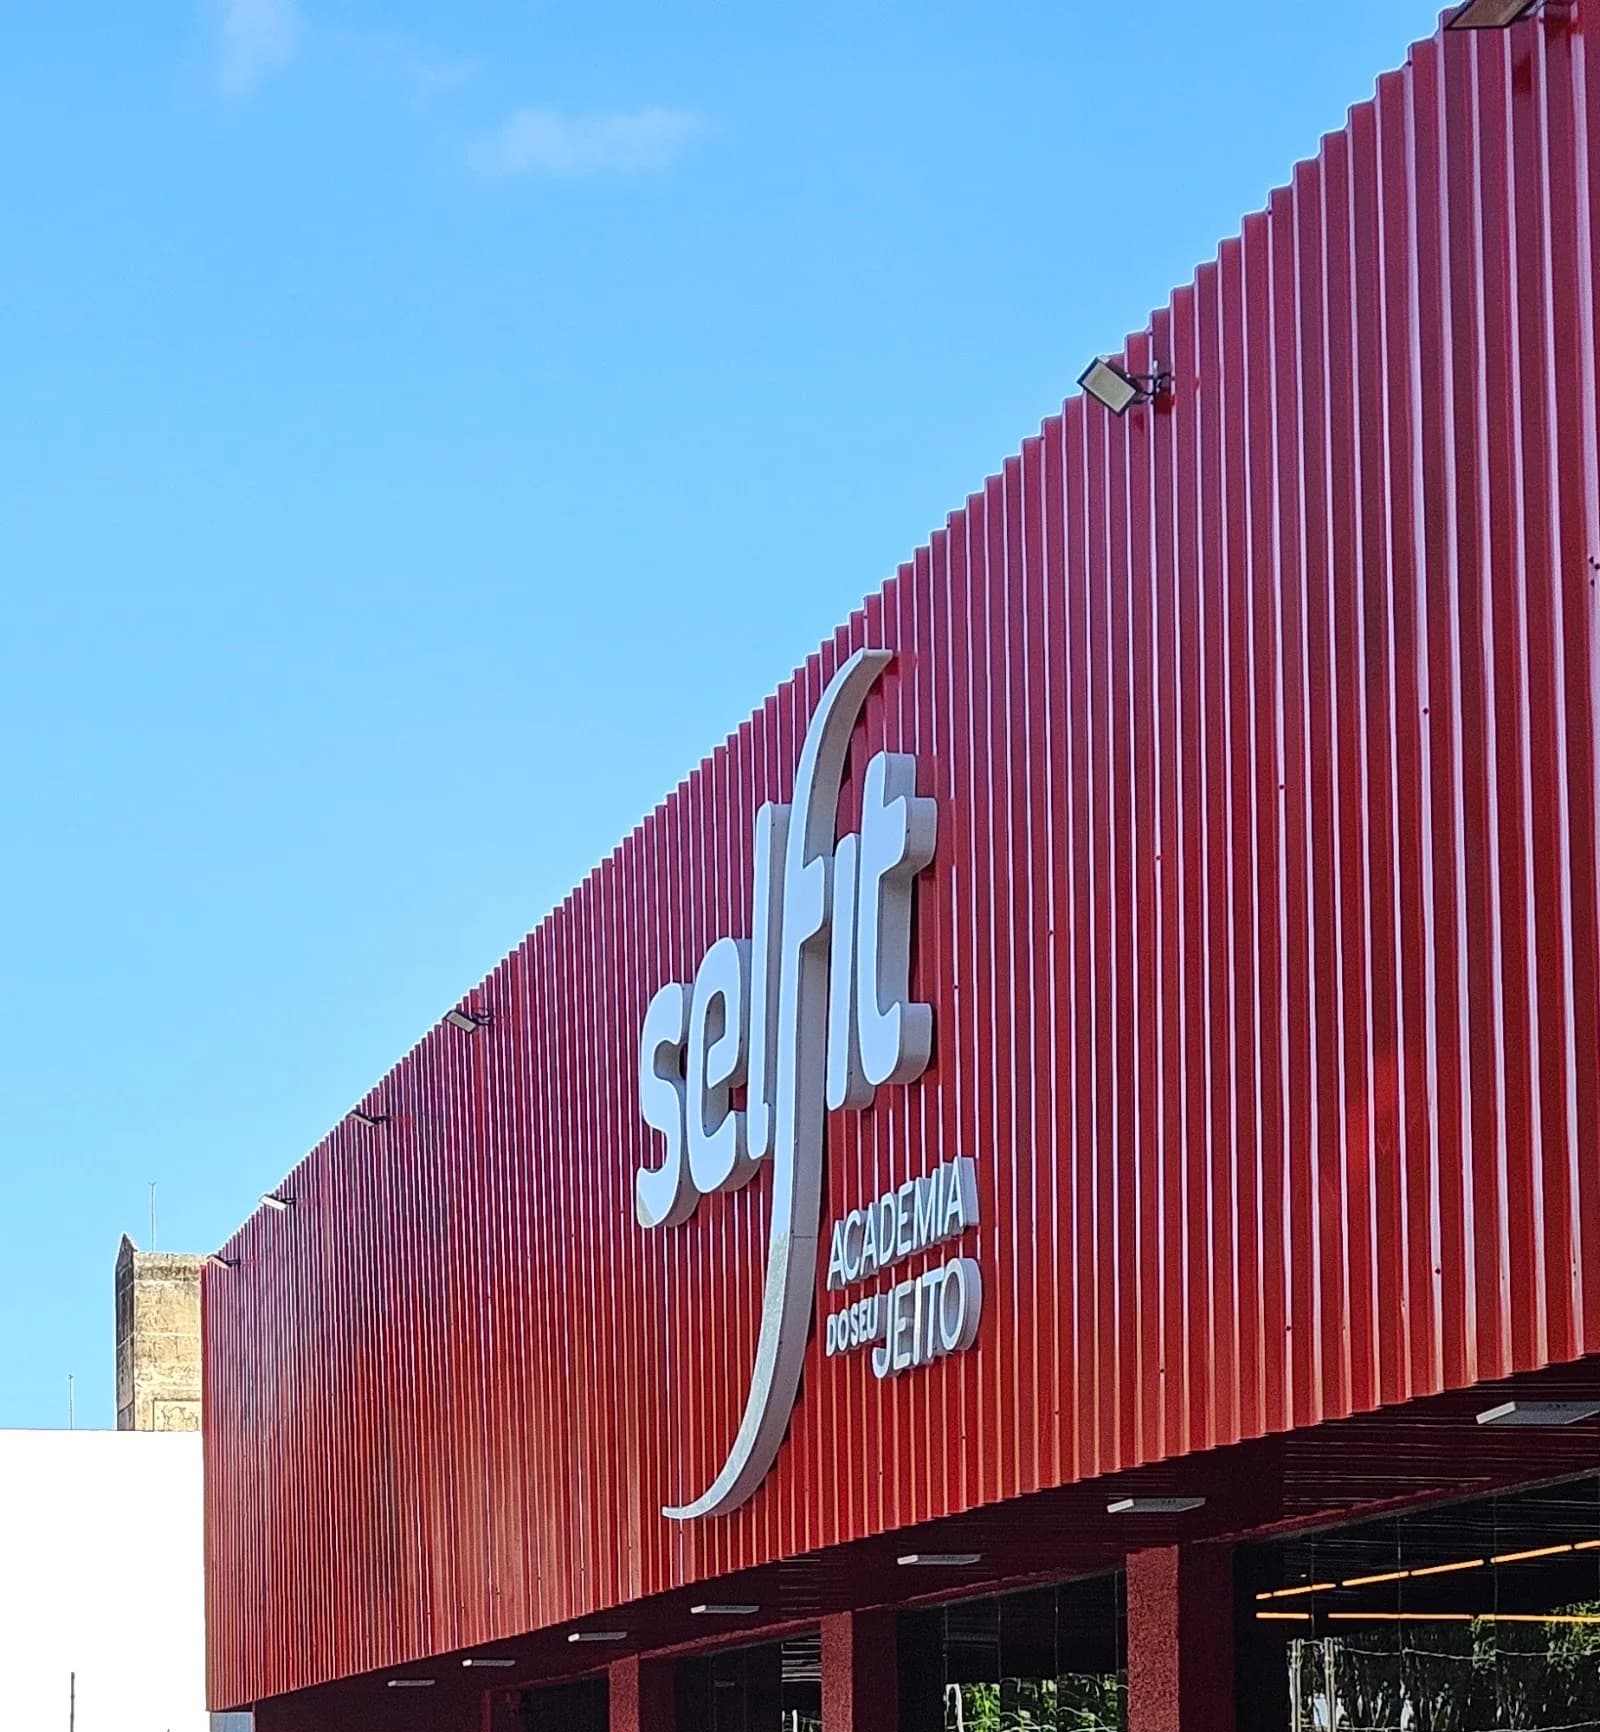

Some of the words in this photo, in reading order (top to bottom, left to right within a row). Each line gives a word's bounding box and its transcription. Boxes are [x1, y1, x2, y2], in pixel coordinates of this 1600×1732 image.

[637, 648, 937, 1520] selfit
[827, 1156, 979, 1291] ACADEMIA
[872, 1258, 982, 1379] JEITO
